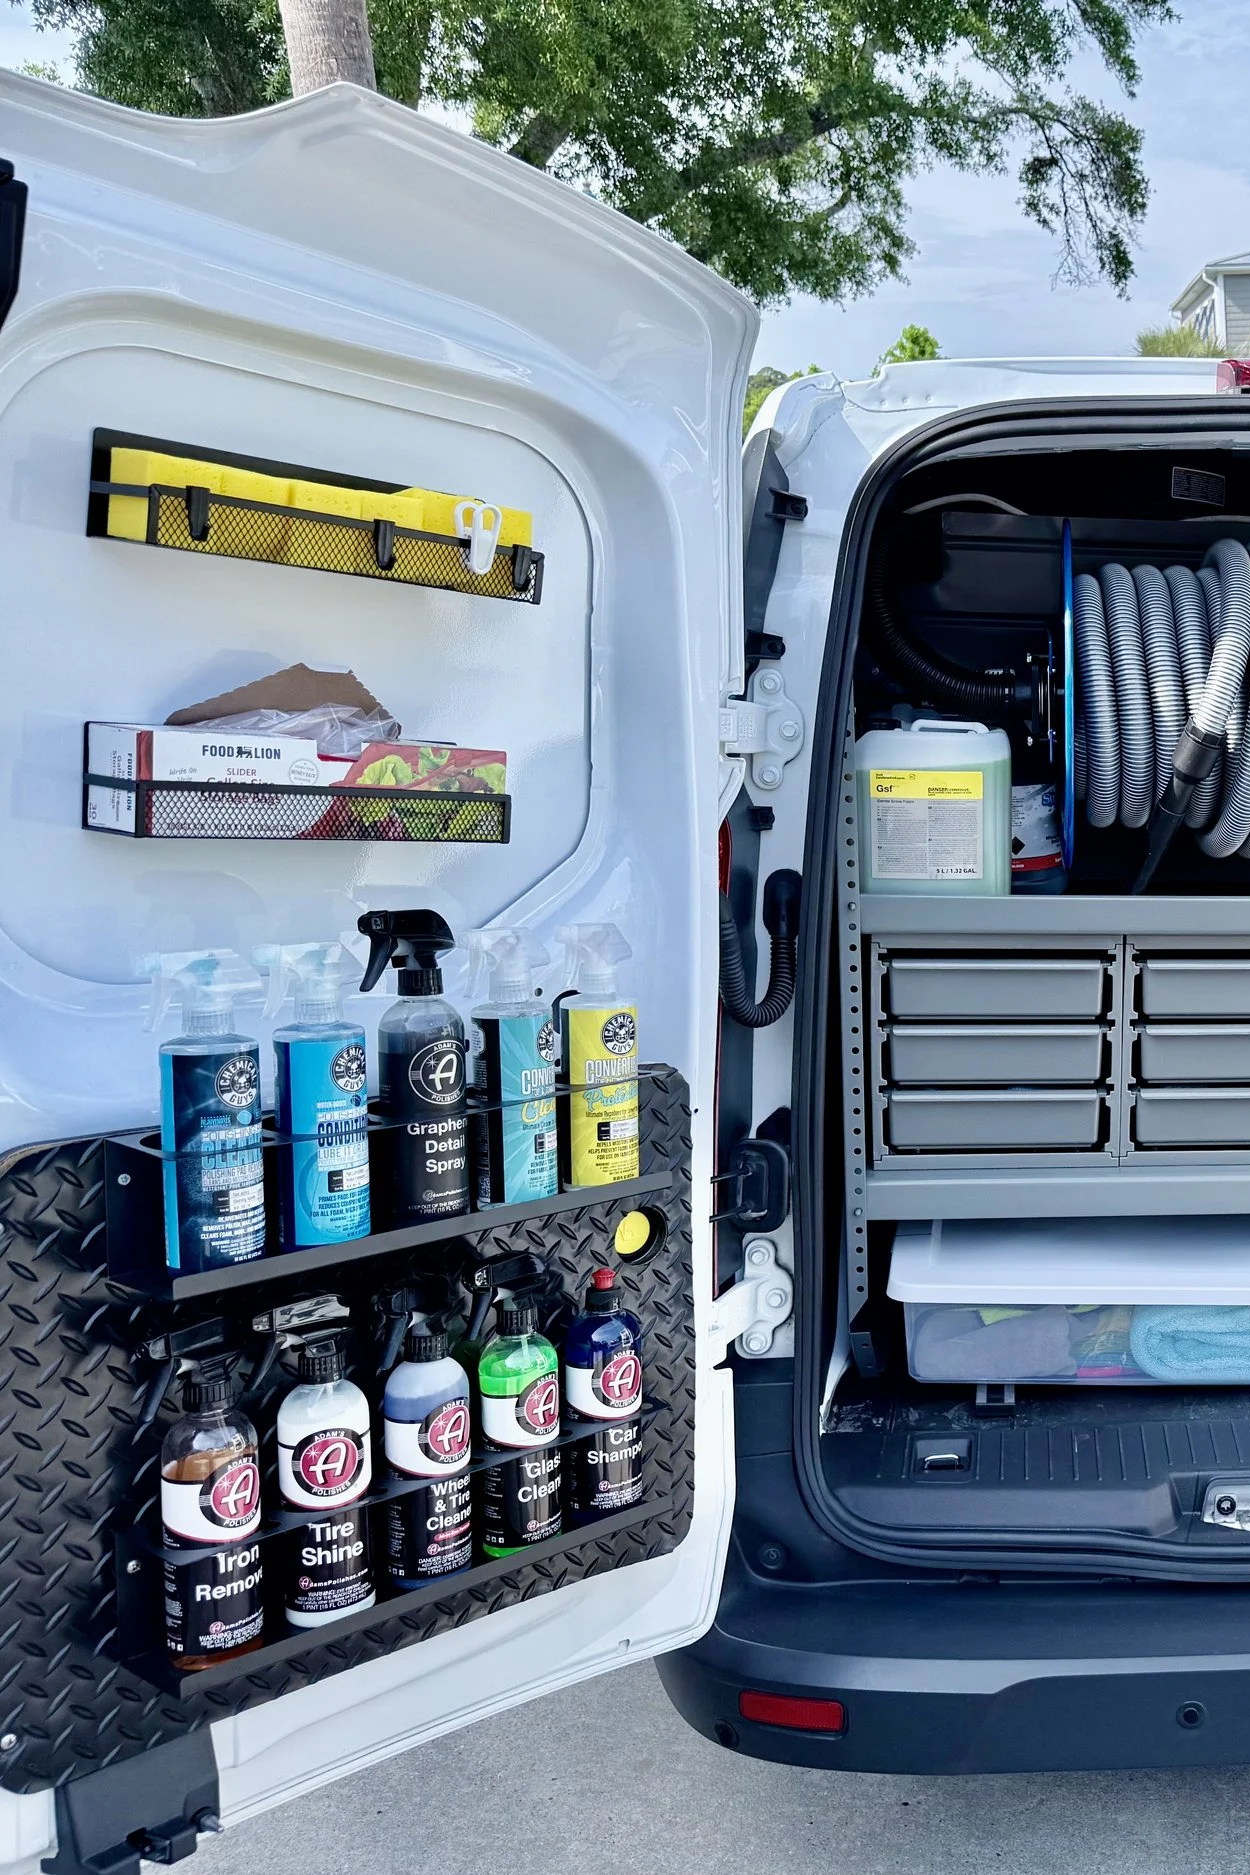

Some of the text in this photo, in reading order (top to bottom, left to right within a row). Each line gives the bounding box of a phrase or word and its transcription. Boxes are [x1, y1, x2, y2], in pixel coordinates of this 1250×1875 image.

[202, 744, 281, 760] FOOD LION
[227, 768, 257, 776] SLIDER
[876, 784, 893, 793] Gsf
[604, 1016, 635, 1037] CHEMICAL
[433, 1043, 457, 1052] ADAM'S
[612, 1041, 631, 1052] GUYS
[335, 1048, 366, 1072] CHEMICAL
[220, 1061, 257, 1087] CHEMICAL
[428, 1053, 458, 1091] A
[344, 1078, 364, 1090] GUYS
[229, 1091, 254, 1105] GUYS
[319, 1145, 341, 1160] LUBE
[425, 1134, 465, 1154] Detail
[425, 1155, 466, 1175] Spray
[613, 1350, 635, 1360] ADAM'S
[537, 1374, 555, 1387] ADAM'S
[608, 1359, 636, 1398] A
[442, 1400, 465, 1412] ADAM'S
[532, 1383, 556, 1426] A
[314, 1430, 346, 1441] ADAM'S
[437, 1410, 464, 1453] A
[610, 1425, 638, 1445] Car
[227, 1456, 253, 1471] ADAM'S
[309, 1441, 348, 1486] A
[221, 1468, 253, 1517] A
[312, 1481, 352, 1496] POLISHES
[432, 1473, 471, 1497] Wheel
[435, 1488, 470, 1513] & Tire
[223, 1509, 258, 1528] POLISHES
[312, 1520, 355, 1543] Tire
[214, 1543, 260, 1575] Iron
[301, 1539, 364, 1567] Shine
[299, 1567, 369, 1590] AdamsPolishes.com
[306, 1603, 319, 1611] PINT
